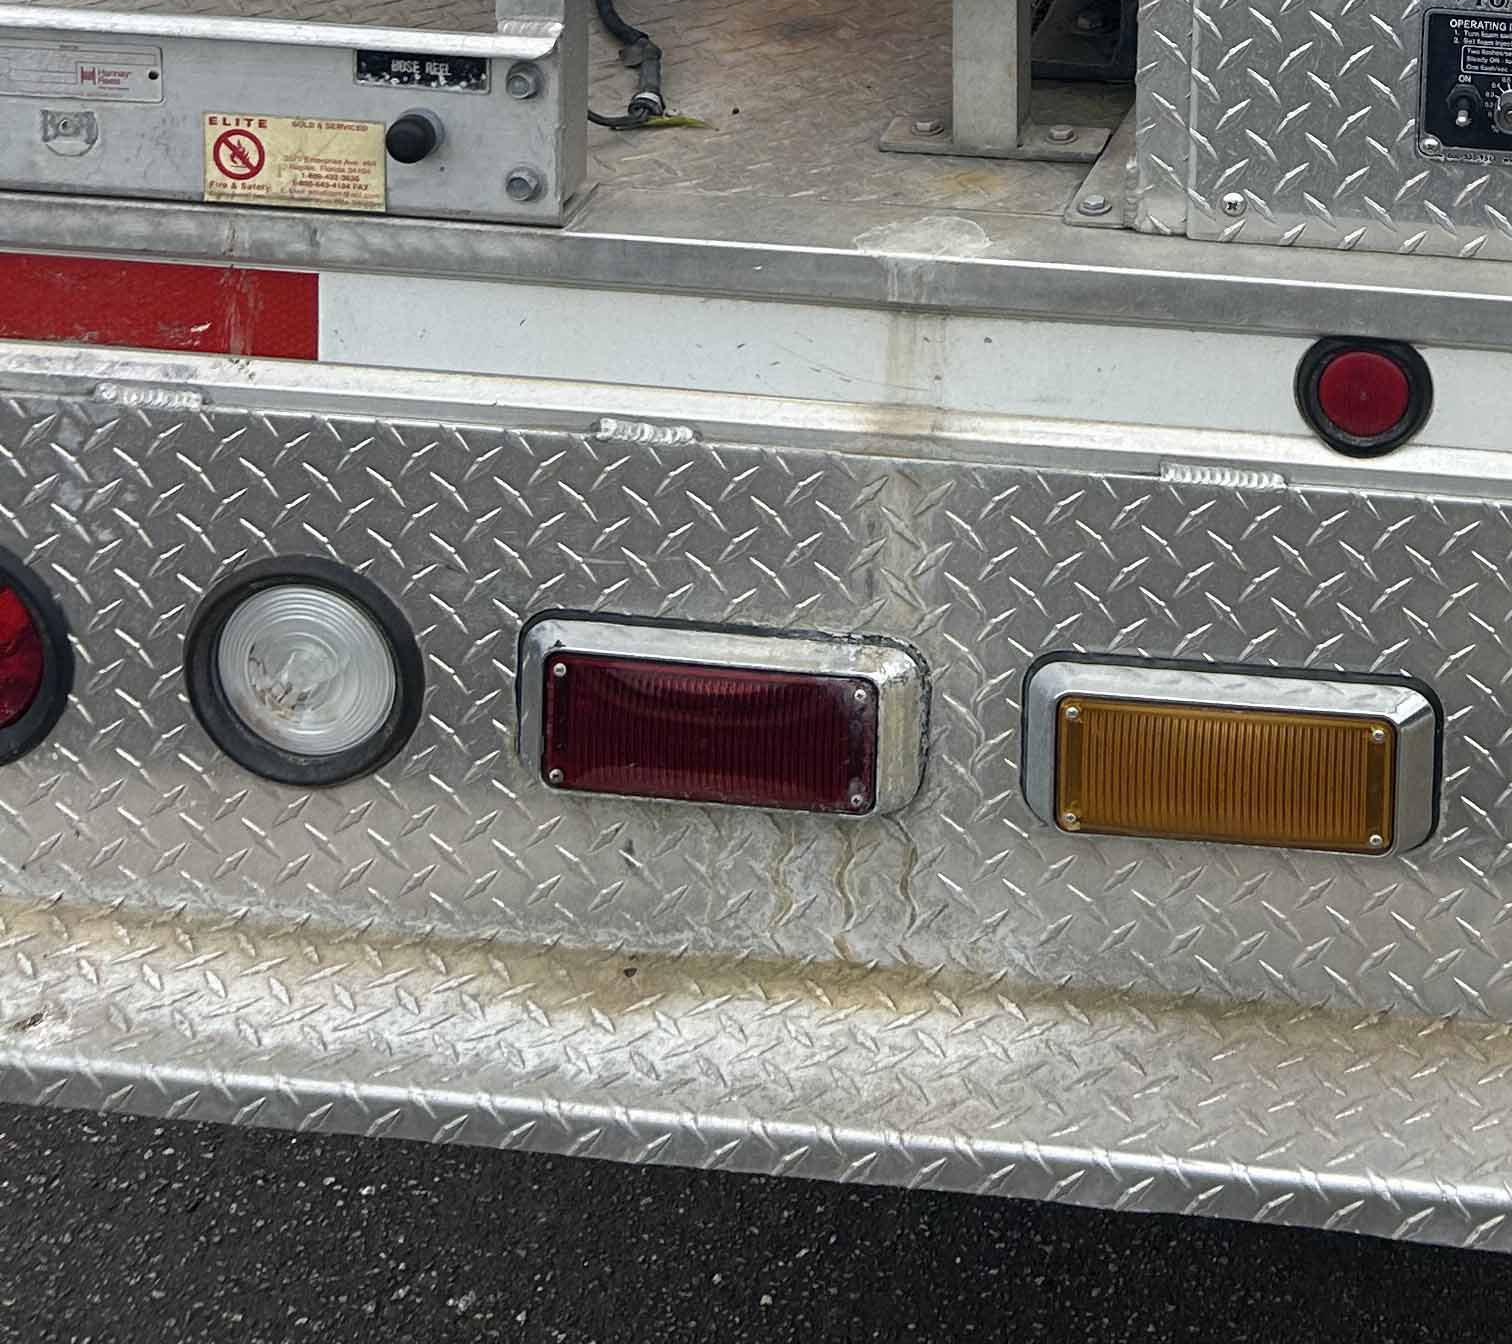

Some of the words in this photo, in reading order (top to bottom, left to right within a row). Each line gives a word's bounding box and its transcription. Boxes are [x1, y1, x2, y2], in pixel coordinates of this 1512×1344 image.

[1450, 18, 1507, 31] OPERATING
[391, 59, 420, 73] HOSE
[1458, 74, 1471, 82] ON
[208, 116, 268, 128] ELITE
